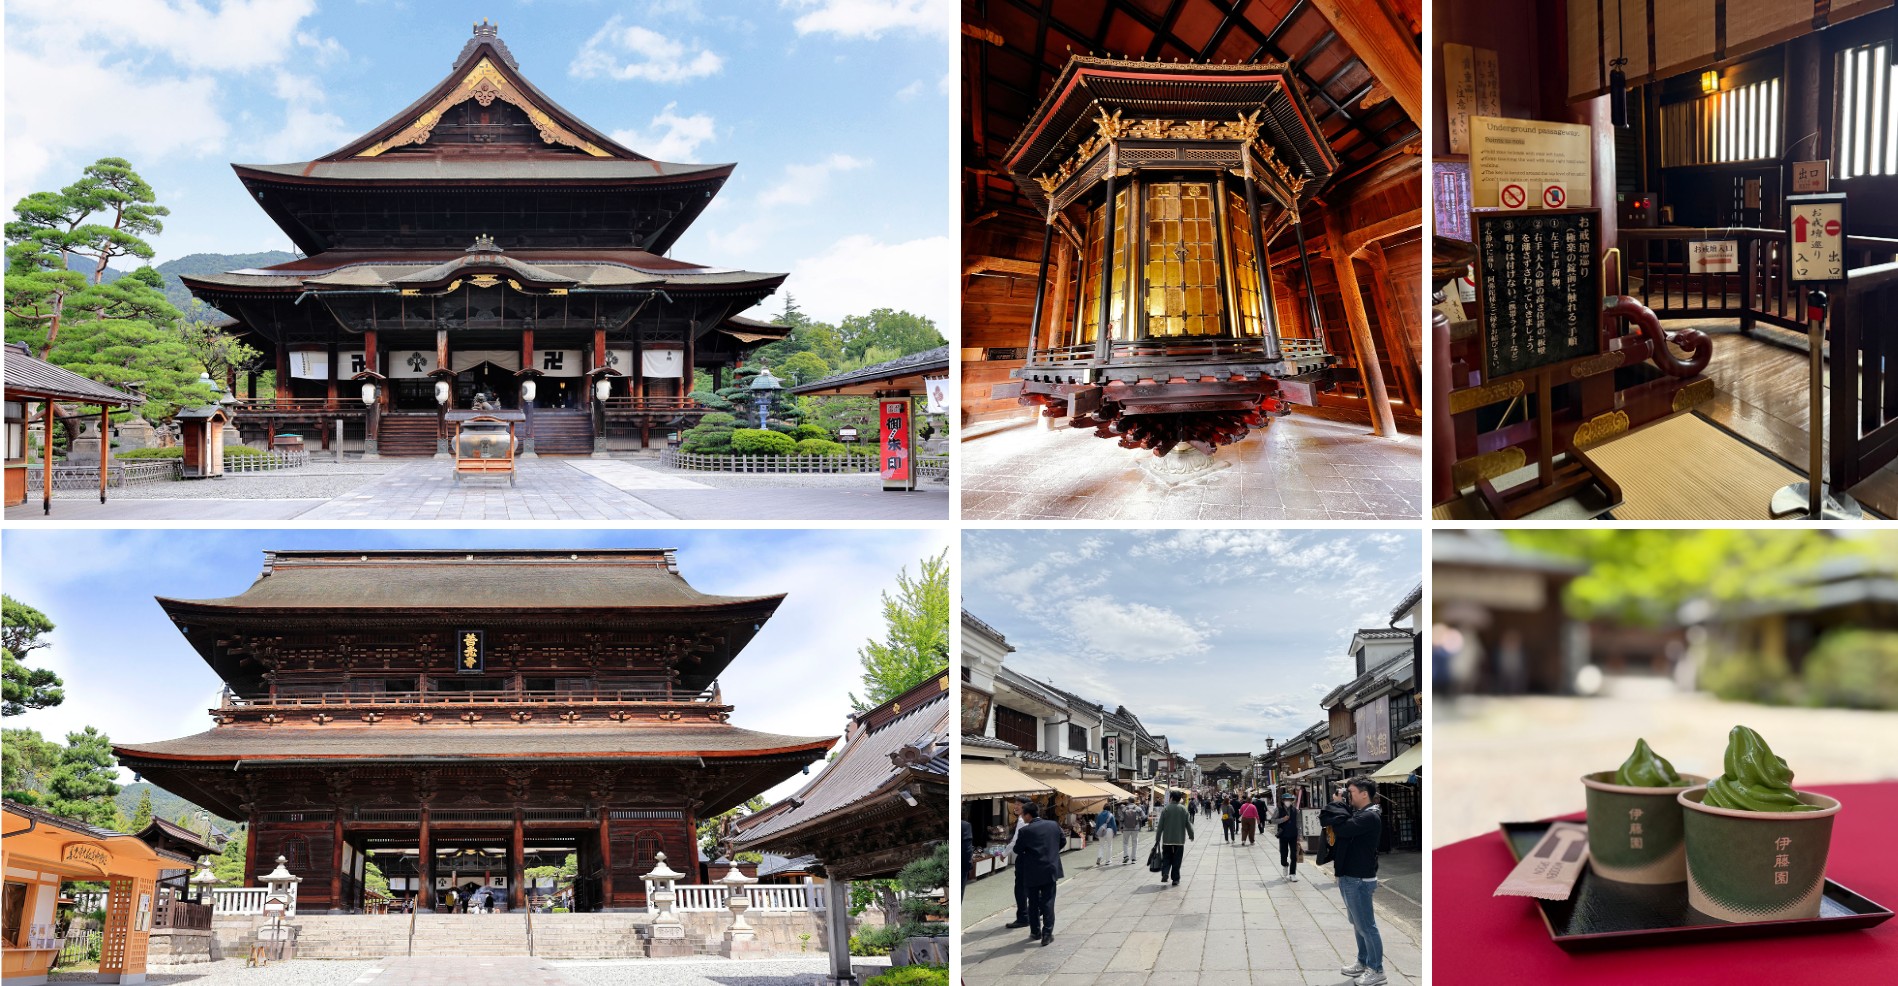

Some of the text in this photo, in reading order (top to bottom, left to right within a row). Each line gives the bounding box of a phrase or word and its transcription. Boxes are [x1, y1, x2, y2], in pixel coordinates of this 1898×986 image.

[1486, 123, 1537, 134] Underground
[1799, 167, 1819, 180] 出口
[1579, 216, 1591, 278] お戒壇巡り
[1811, 208, 1824, 260] お戒壇巡り
[1795, 252, 1809, 276] 入口
[1828, 250, 1841, 275] 出口
[886, 417, 902, 471] 御朱印
[463, 632, 478, 669] 善光寺
[1628, 807, 1644, 850] 伊藤園
[1774, 836, 1792, 885] 伊藤園
